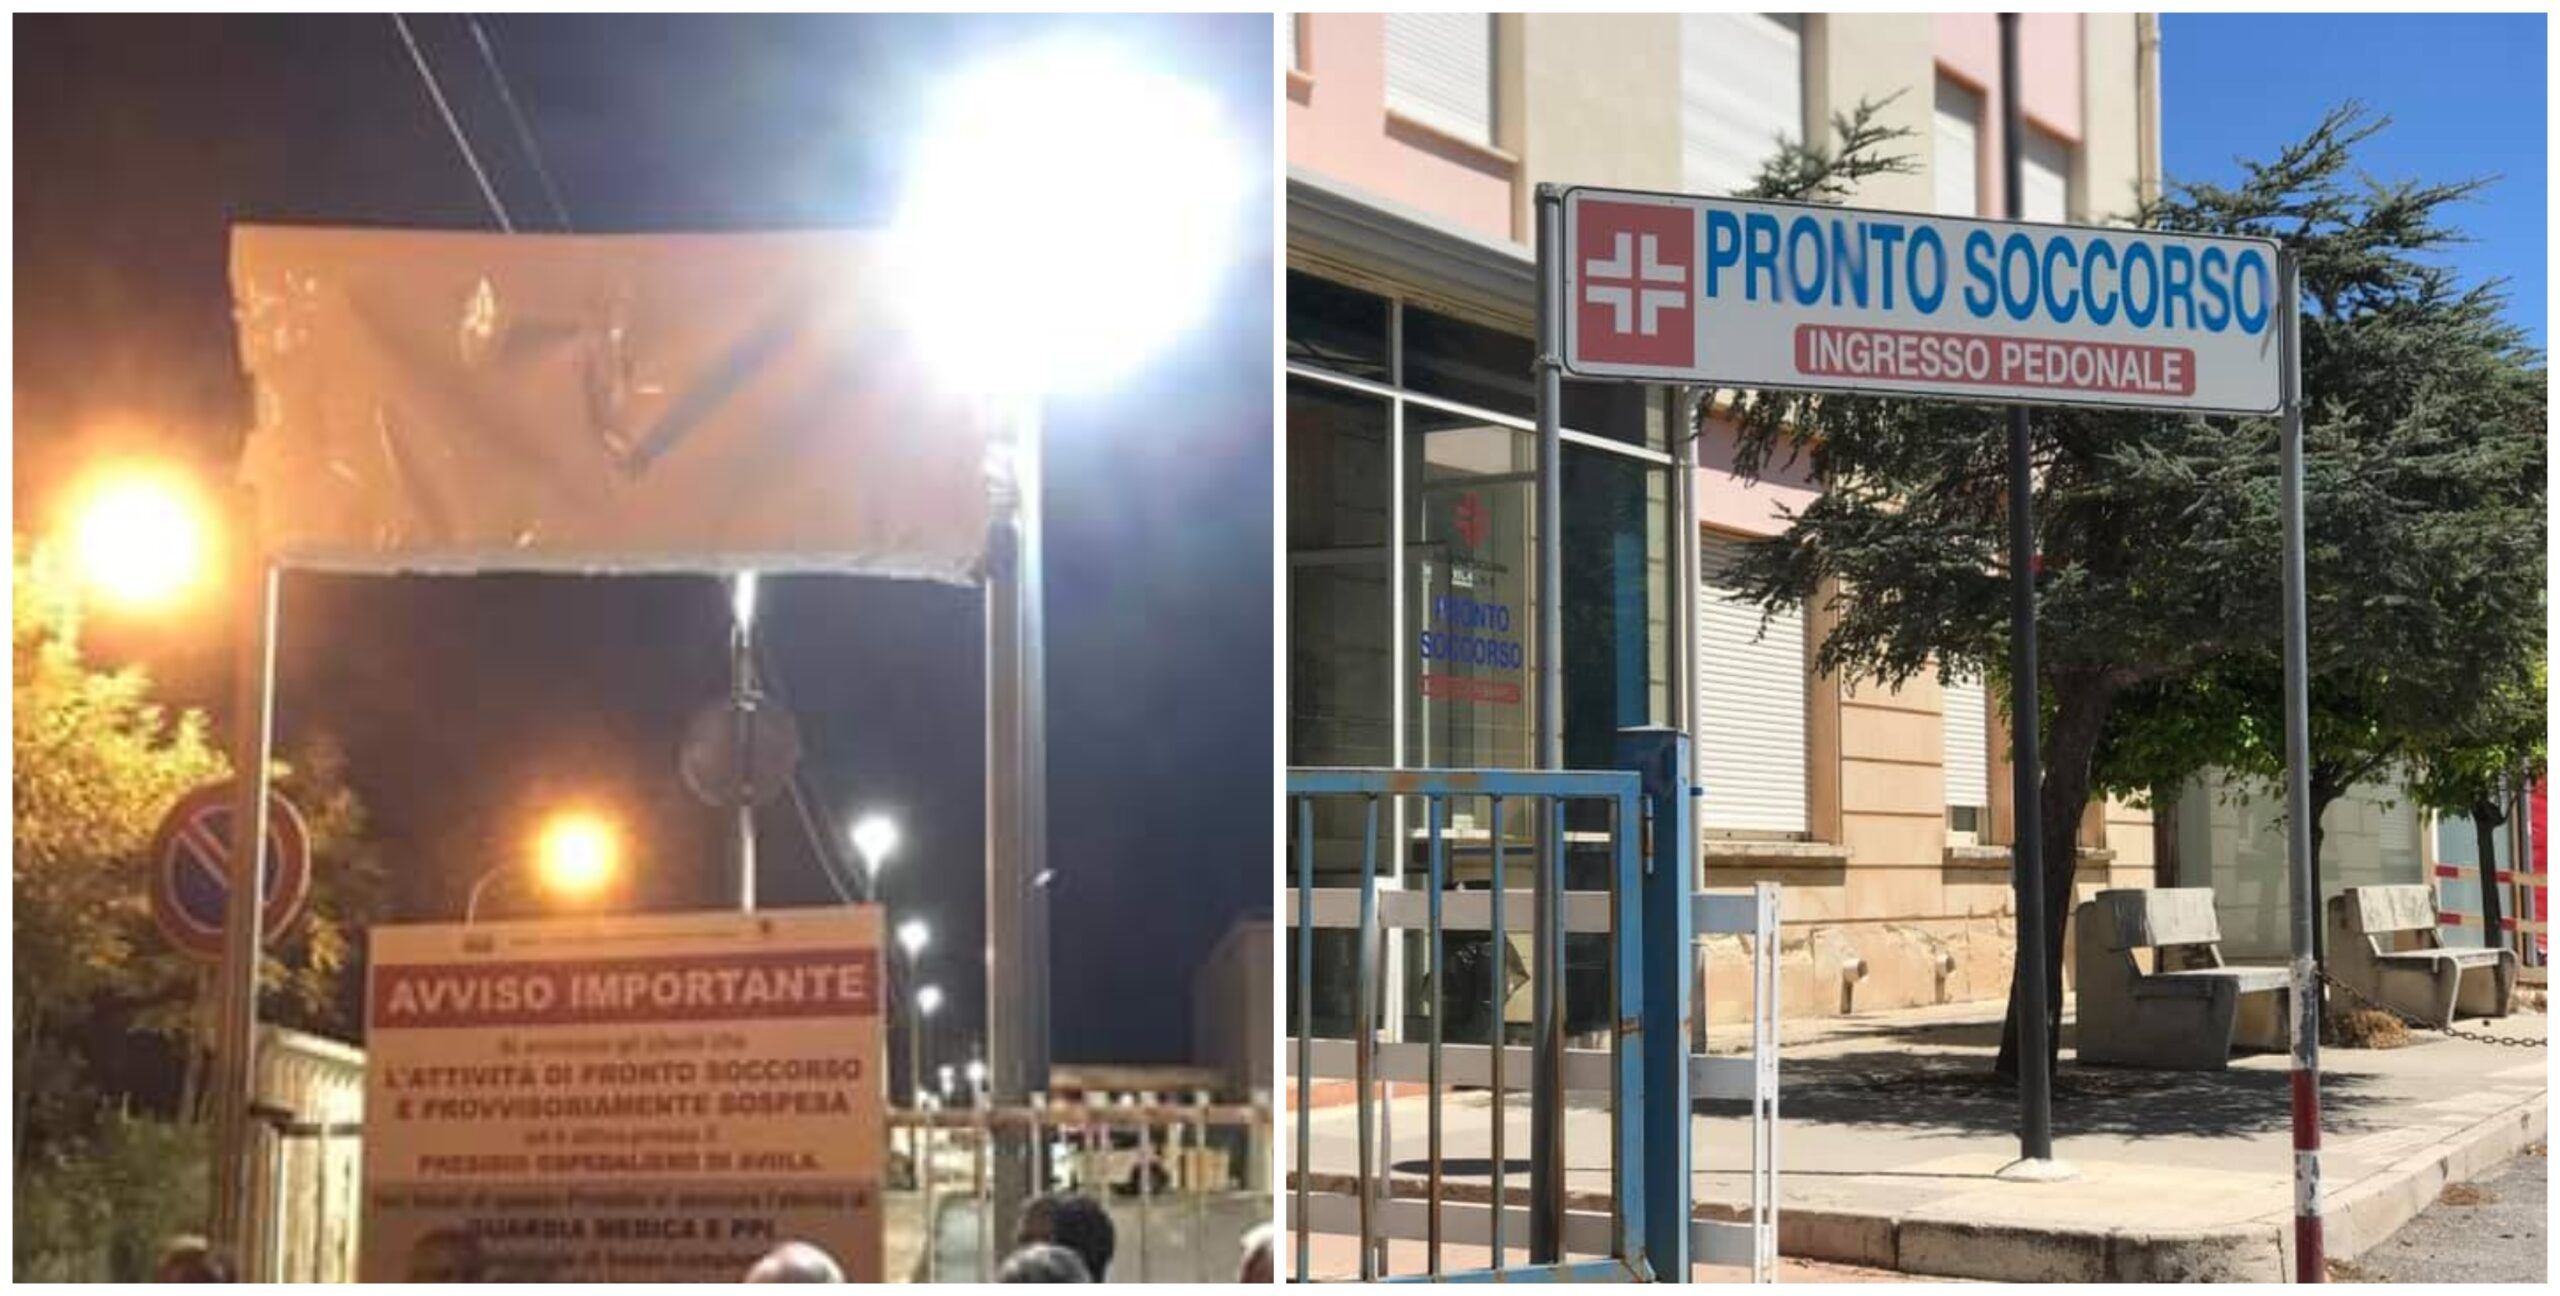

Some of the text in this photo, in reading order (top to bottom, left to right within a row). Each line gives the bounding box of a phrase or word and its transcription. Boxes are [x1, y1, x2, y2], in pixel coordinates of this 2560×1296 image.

[1705, 208, 2270, 335] PRONTO SOCCORSO
[1808, 328, 2183, 392] INGRESSO PEDONALE
[1421, 630, 1522, 669] SOCCORSO
[388, 963, 866, 1014] AVVISO IMPORTANTE
[545, 1063, 573, 1084] DI
[582, 1061, 697, 1085] PRONTO
[704, 1058, 861, 1082] SOCCORSO
[719, 1090, 849, 1116] SOSPESA
